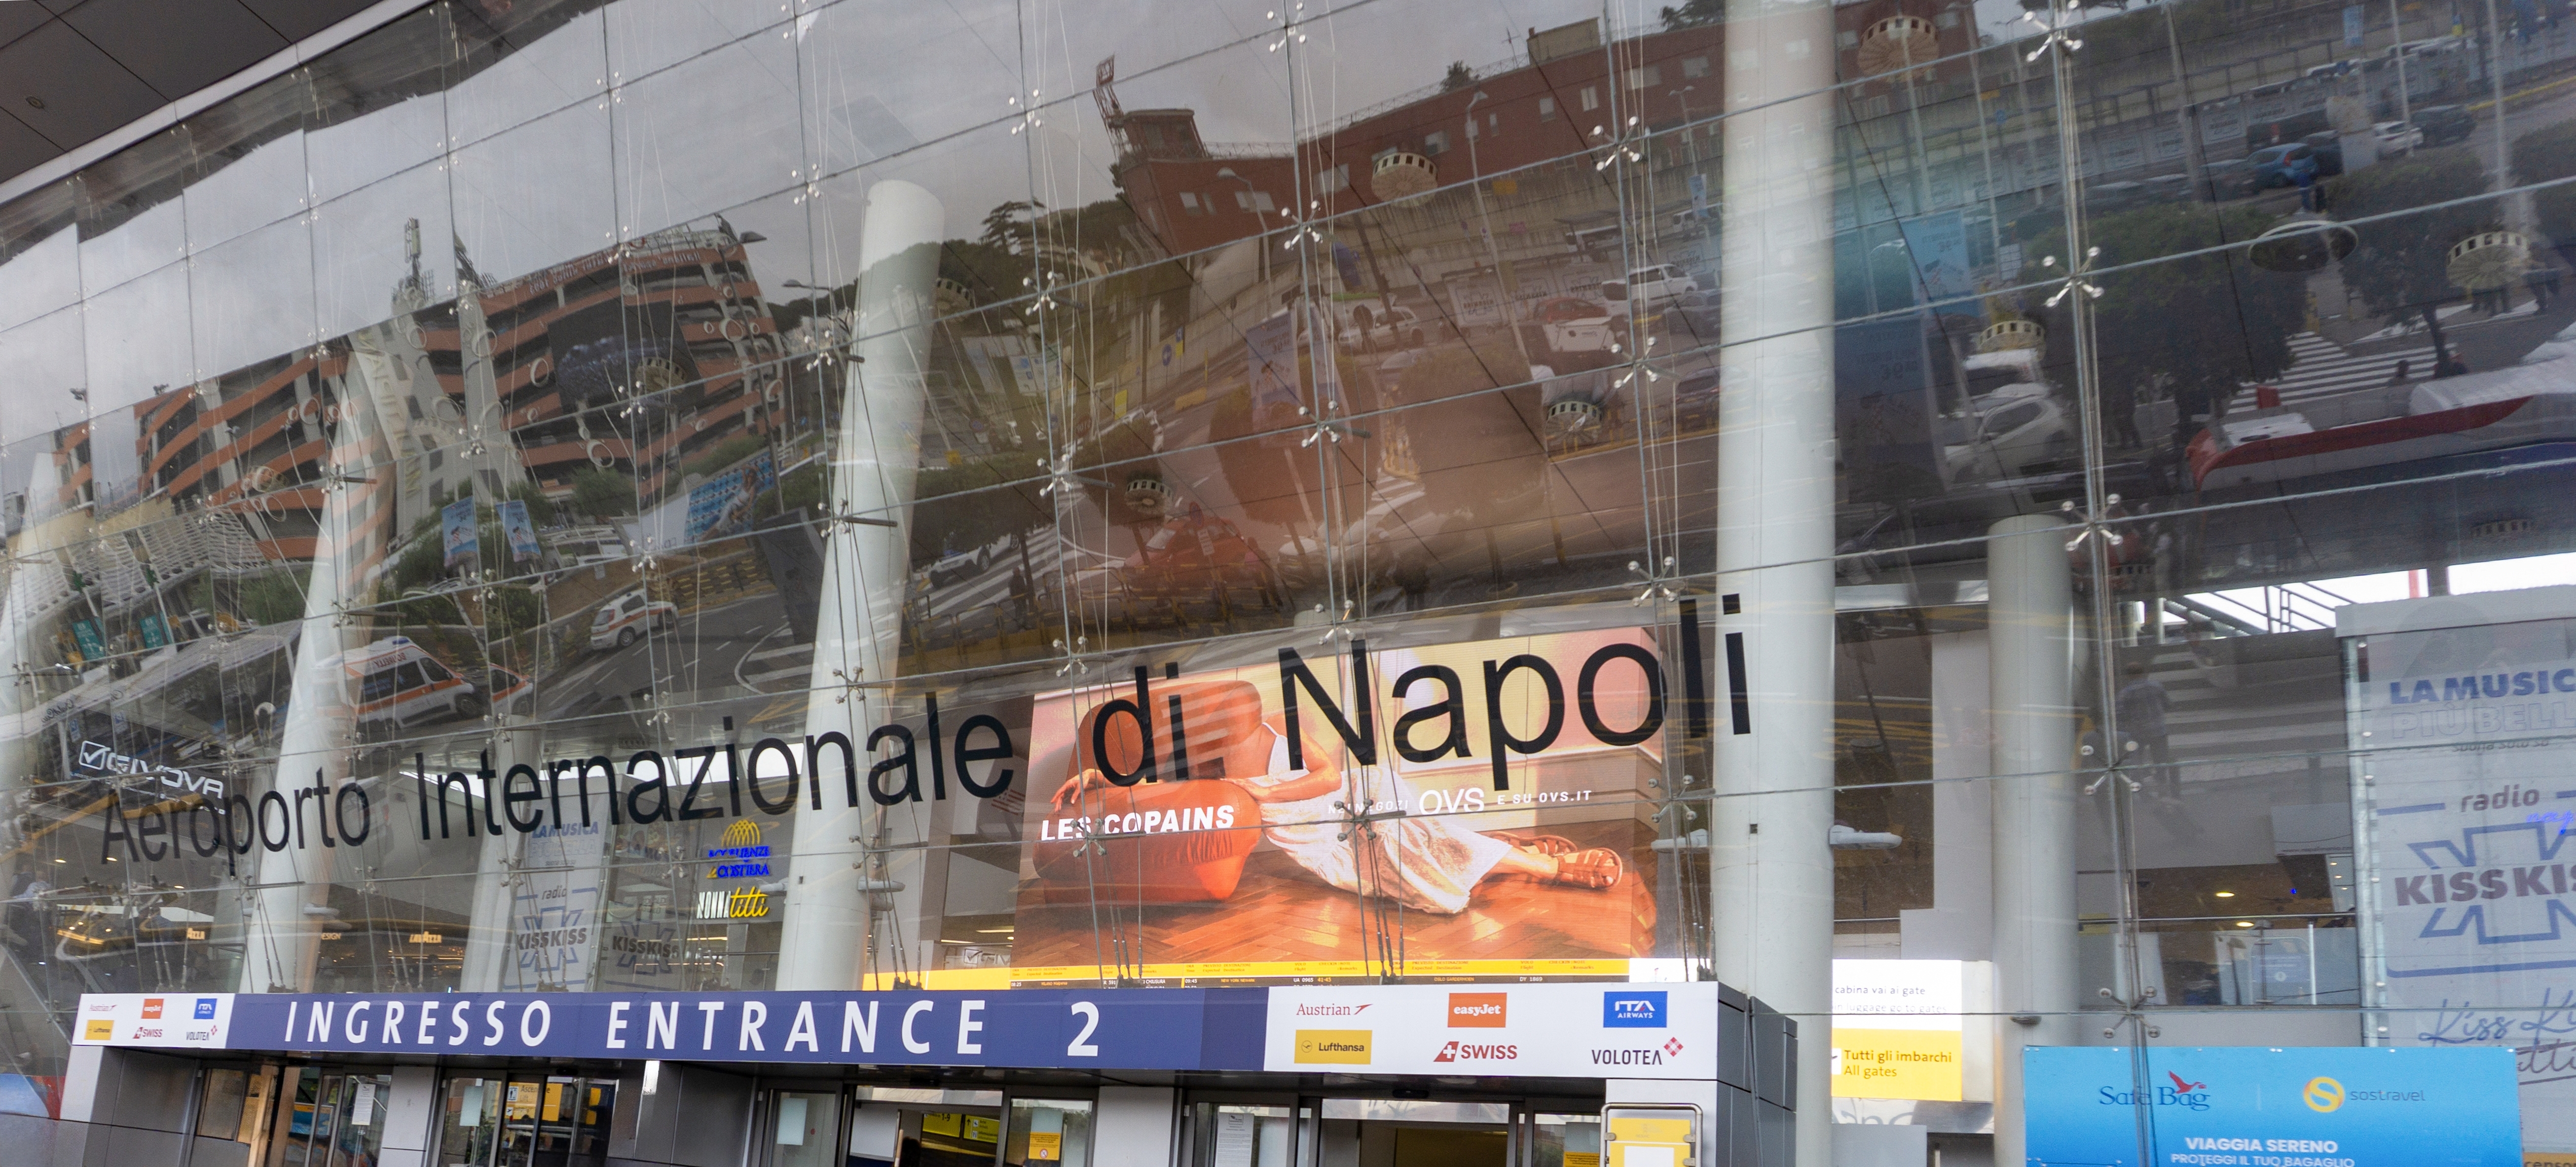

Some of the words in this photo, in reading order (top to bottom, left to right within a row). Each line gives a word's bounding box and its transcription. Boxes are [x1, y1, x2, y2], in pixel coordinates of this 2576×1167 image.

[102, 767, 371, 877] Aeroporto
[415, 691, 1014, 841] Internazionale
[1092, 662, 1190, 787] di
[1278, 593, 1751, 791] Napoli
[106, 751, 224, 799] GIVOVA
[1419, 787, 1485, 815] OVS
[1497, 794, 1505, 805] E
[1513, 793, 1532, 804] SU
[1539, 790, 1593, 803] OVS.IT
[2461, 784, 2540, 812] radio
[1041, 814, 1092, 842] LES
[1103, 805, 1235, 837] COPAINS
[541, 885, 567, 900] radio
[696, 890, 731, 919] NONNA
[729, 886, 769, 918] titti
[321, 932, 341, 940] ESIGN
[516, 927, 587, 951] KISSKISS
[612, 935, 681, 958] KISSKISS
[1835, 986, 1868, 994] cabina
[1872, 986, 1887, 994] vai
[1890, 986, 1899, 994] ai
[1902, 987, 1926, 997] gate
[1297, 1002, 1351, 1016] Austrian
[1453, 1003, 1501, 1017] easyJet
[1614, 1000, 1651, 1012] ITA
[285, 1000, 551, 1047] INGRESSO
[607, 1000, 986, 1055] ENTRANCE
[1067, 1001, 1099, 1057] 2
[2418, 998, 2517, 1046] Kiss
[142, 1029, 163, 1038] SWISS
[1318, 1042, 1365, 1053] Lufthansa
[1461, 1044, 1518, 1061] SWISS
[1591, 1049, 1663, 1066] VOLOTEA
[1844, 1050, 1874, 1061] Tutti
[1878, 1051, 1893, 1064] gli
[1896, 1051, 1952, 1063] imbarchi
[1844, 1065, 1860, 1075] All
[1864, 1067, 1897, 1079] gates
[2157, 1086, 2211, 1111] Bag
[2350, 1088, 2425, 1102] sostravel
[2185, 1137, 2261, 1152] VIAGGIA
[2266, 1138, 2338, 1153] SERENO
[2170, 1153, 2236, 1166] PROTEGGI
[2284, 1156, 2355, 1167] BAGAGLIO
